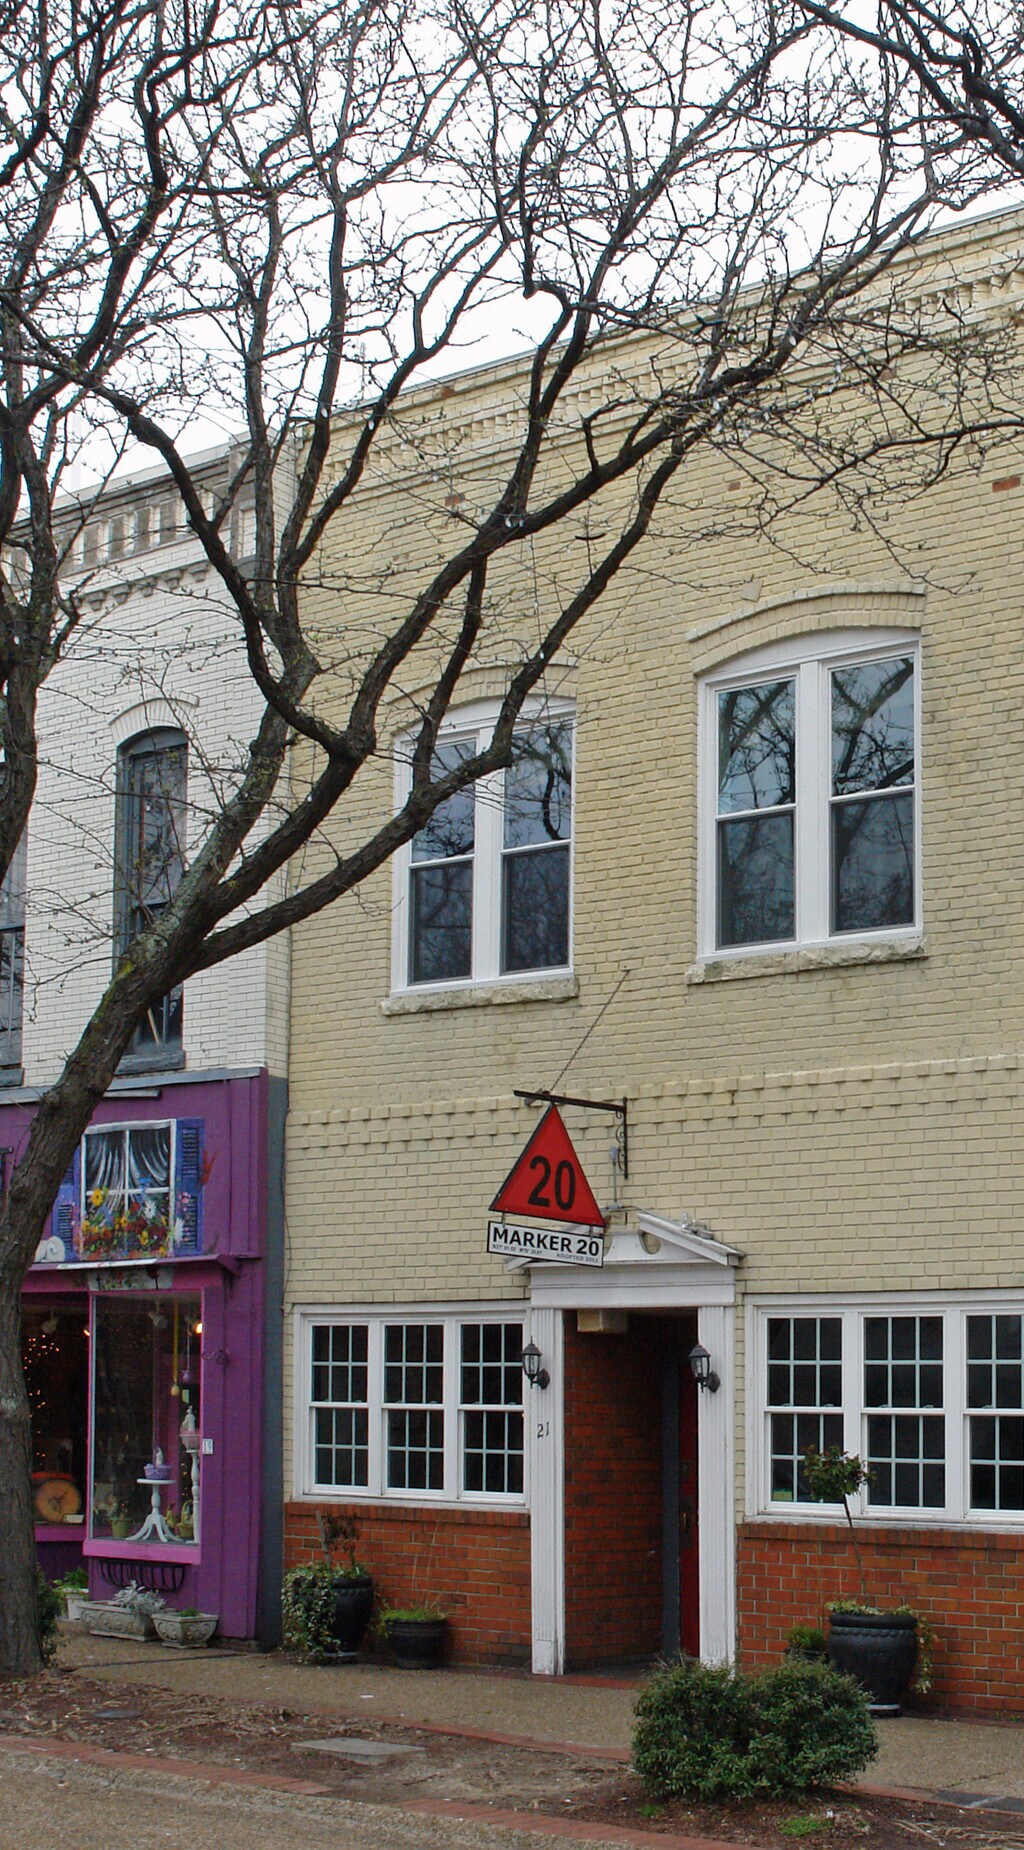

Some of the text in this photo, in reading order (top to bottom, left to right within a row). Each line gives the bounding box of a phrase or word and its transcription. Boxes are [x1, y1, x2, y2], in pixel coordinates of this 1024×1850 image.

[528, 1155, 576, 1211] 20
[493, 1226, 572, 1253] MARKER
[576, 1238, 600, 1256] 20
[537, 1421, 550, 1438] 21
